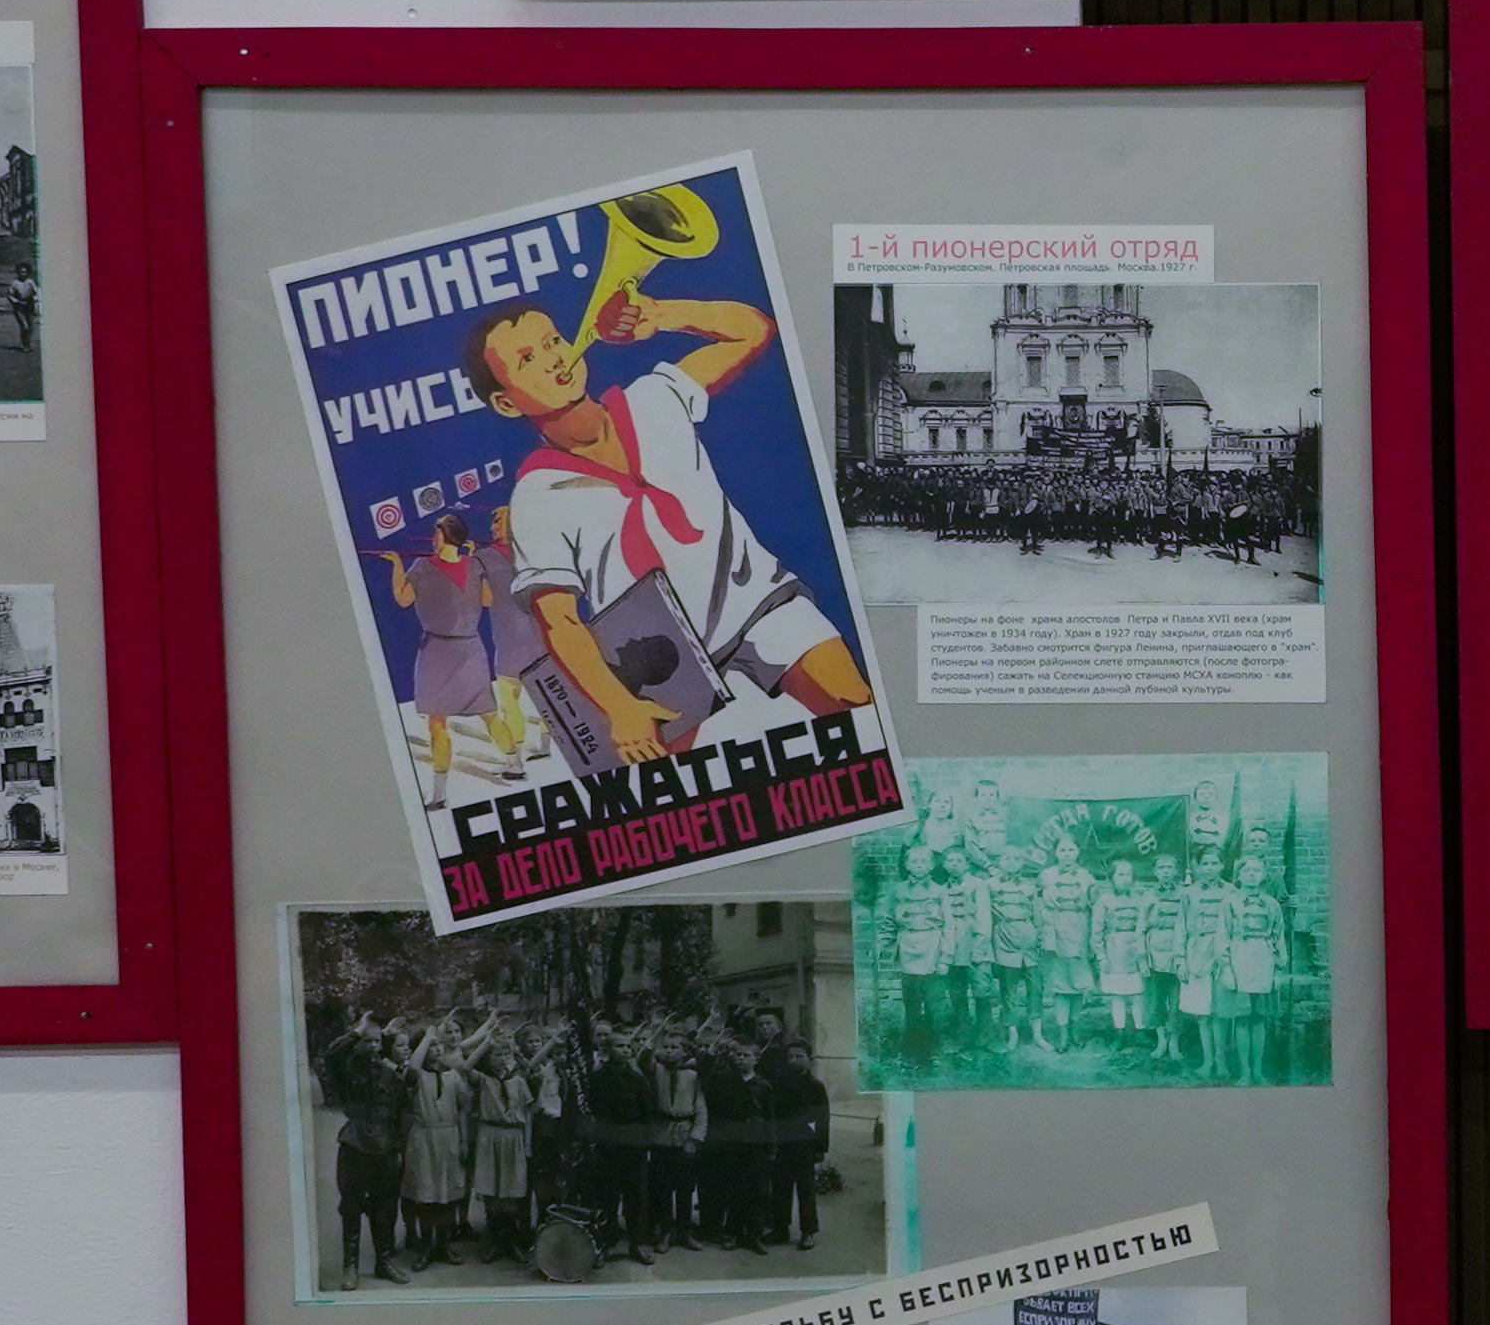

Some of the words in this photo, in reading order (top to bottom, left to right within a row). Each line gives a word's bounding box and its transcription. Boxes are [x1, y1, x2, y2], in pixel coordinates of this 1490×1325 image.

[299, 212, 588, 349] ПИОНЕР!
[847, 261, 854, 271] В
[857, 262, 995, 272] Петровском-Разумовском.
[999, 261, 1060, 273] Петровская
[1063, 263, 1114, 272] площадь.
[1189, 263, 1198, 271] г.
[850, 234, 898, 258] 1-й
[912, 234, 1096, 260] пионерский
[1109, 239, 1198, 262] отряд
[323, 370, 488, 446] УЧИСЬ
[451, 711, 864, 856] СРАЖАТЬСЯ
[443, 862, 489, 912] ЗА
[497, 837, 582, 900] ДЕЛО
[592, 792, 757, 876] РАБОЧЕГО
[767, 758, 899, 831] КЛАССА
[869, 1297, 886, 1319] С
[902, 1223, 1192, 1312] БЕСПРИЗОРНОСТЬЮ
